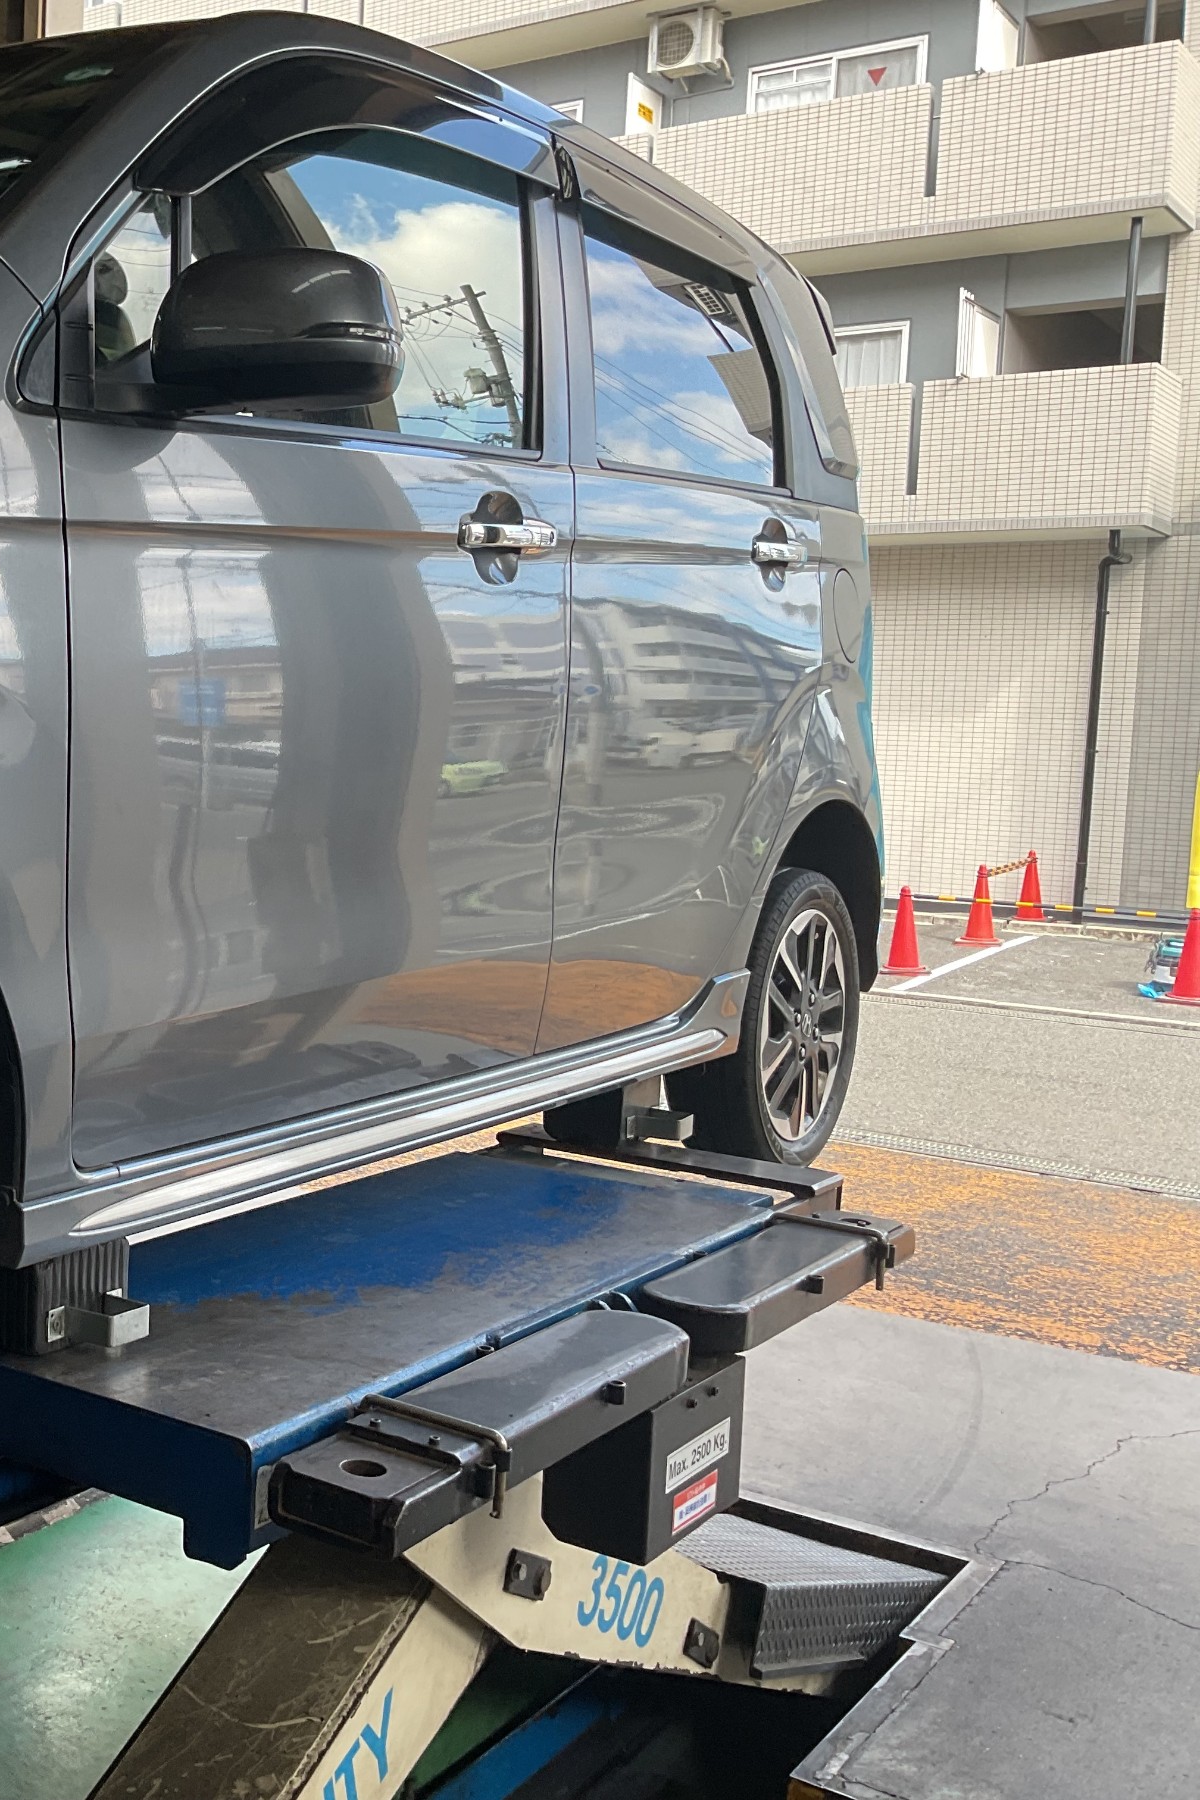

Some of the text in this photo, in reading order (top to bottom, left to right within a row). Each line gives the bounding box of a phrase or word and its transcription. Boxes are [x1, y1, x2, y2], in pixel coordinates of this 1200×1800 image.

[668, 1433, 727, 1481] Max. 2500 Kg.
[577, 1554, 664, 1648] 3500
